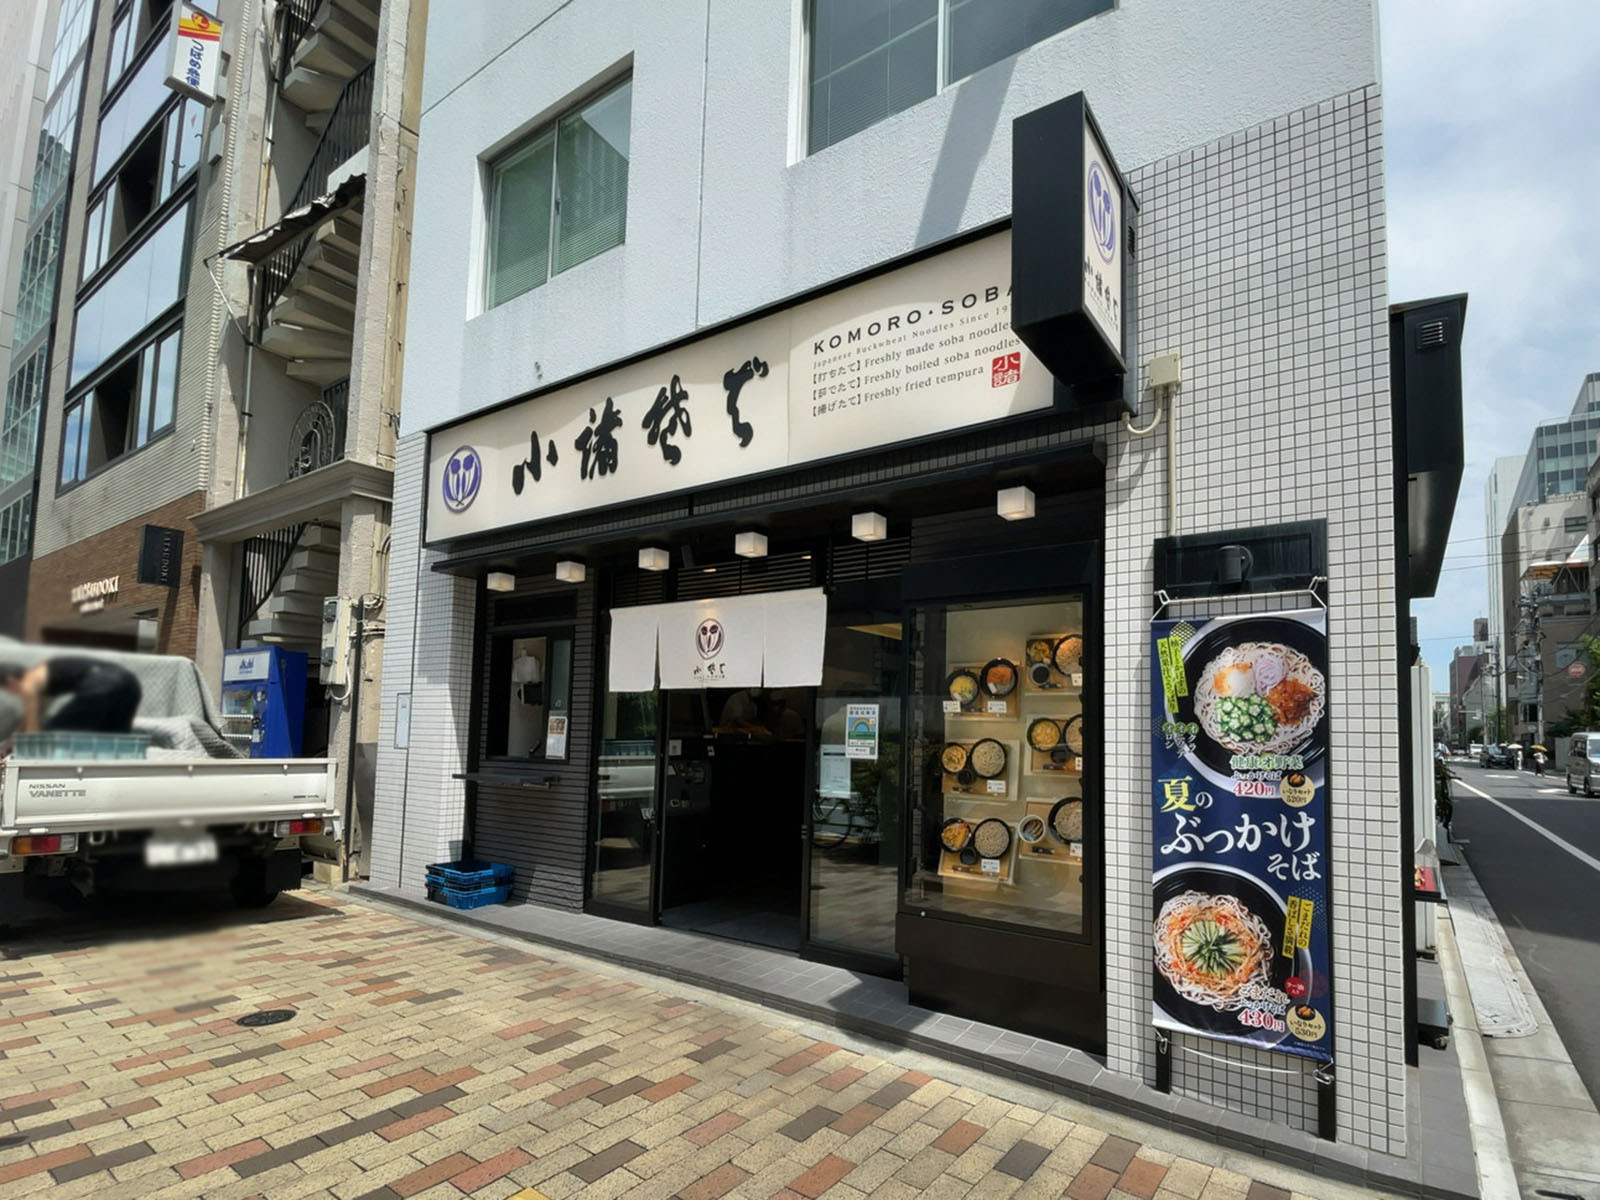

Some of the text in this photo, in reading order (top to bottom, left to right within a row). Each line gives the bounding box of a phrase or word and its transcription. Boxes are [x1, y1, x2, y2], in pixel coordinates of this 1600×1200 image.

[813, 351, 852, 369] Japanese
[857, 335, 906, 354] Buckwheat
[912, 322, 954, 338] Noodles
[960, 311, 989, 325] Since
[864, 351, 901, 368] Freshly
[906, 341, 935, 357] made
[939, 335, 964, 348] soba
[969, 322, 1012, 340] noodle
[864, 368, 901, 385] Freshly
[905, 357, 939, 374] boiled
[944, 351, 970, 365] soba
[974, 337, 1021, 357] noodles
[864, 386, 902, 402] Freshly
[905, 377, 932, 392] fried
[936, 366, 984, 385] tempura
[29, 789, 87, 798] VANETTE
[1158, 776, 1213, 812] 夏の
[1233, 781, 1275, 796] 420円
[1160, 811, 1316, 854] ぶっかけ
[1267, 851, 1321, 881] そば
[1238, 983, 1291, 1005] ごまだれ
[1238, 1008, 1285, 1032] 430円
[1290, 1020, 1323, 1031] いなりセット
[1295, 1027, 1318, 1039] 530円
